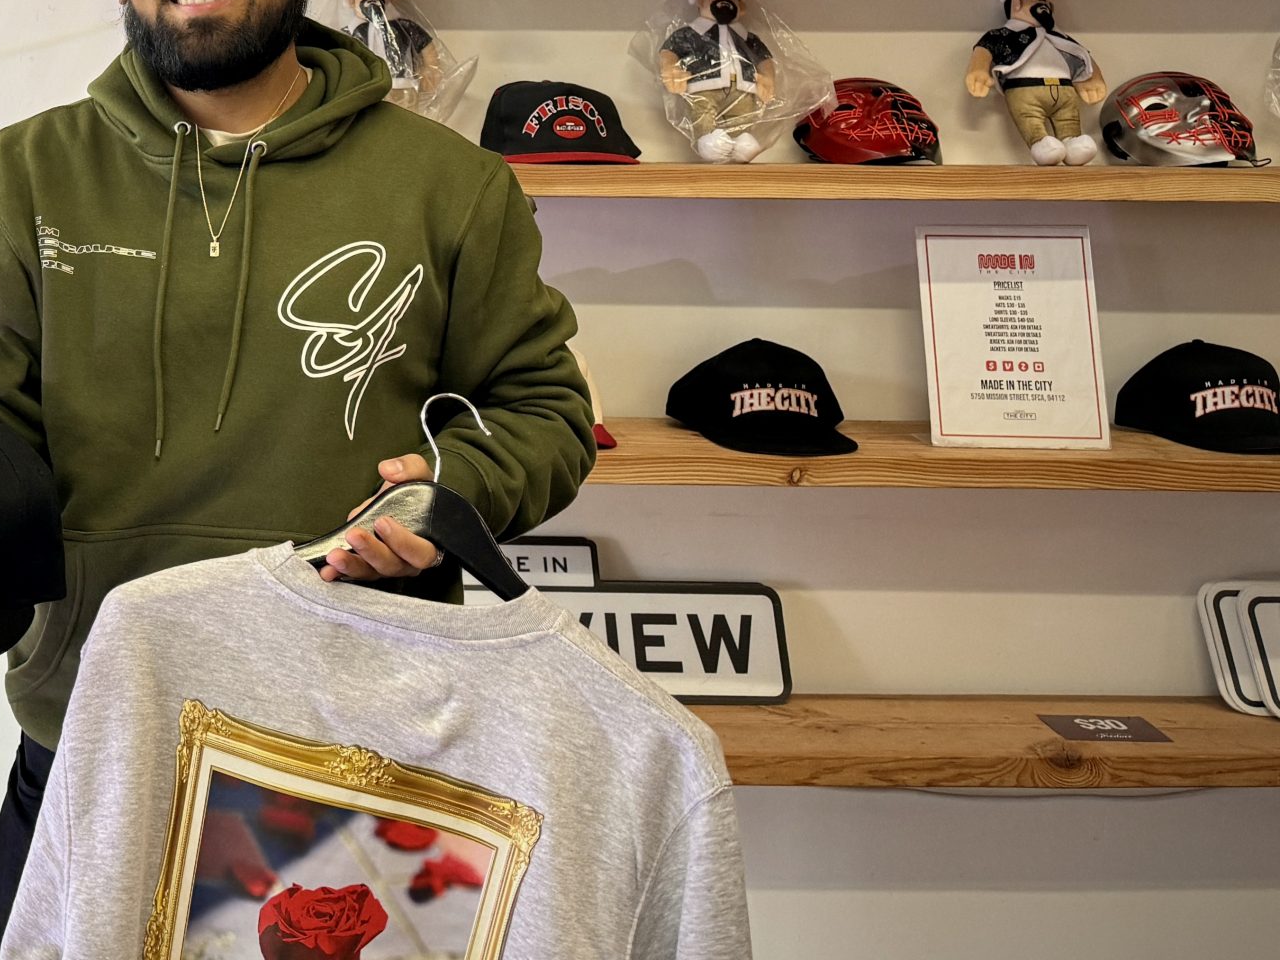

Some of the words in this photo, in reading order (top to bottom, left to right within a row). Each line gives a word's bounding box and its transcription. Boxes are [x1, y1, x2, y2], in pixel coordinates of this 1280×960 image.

[522, 95, 607, 138] FRISCO
[38, 237, 157, 260] ECAUSE
[993, 281, 1023, 289] PRICELIST
[981, 380, 1004, 390] MADE
[1006, 380, 1015, 390] IN
[1017, 381, 1033, 391] THE
[1035, 381, 1053, 391] CITY
[542, 556, 568, 573] IN
[1073, 718, 1129, 731] $30
